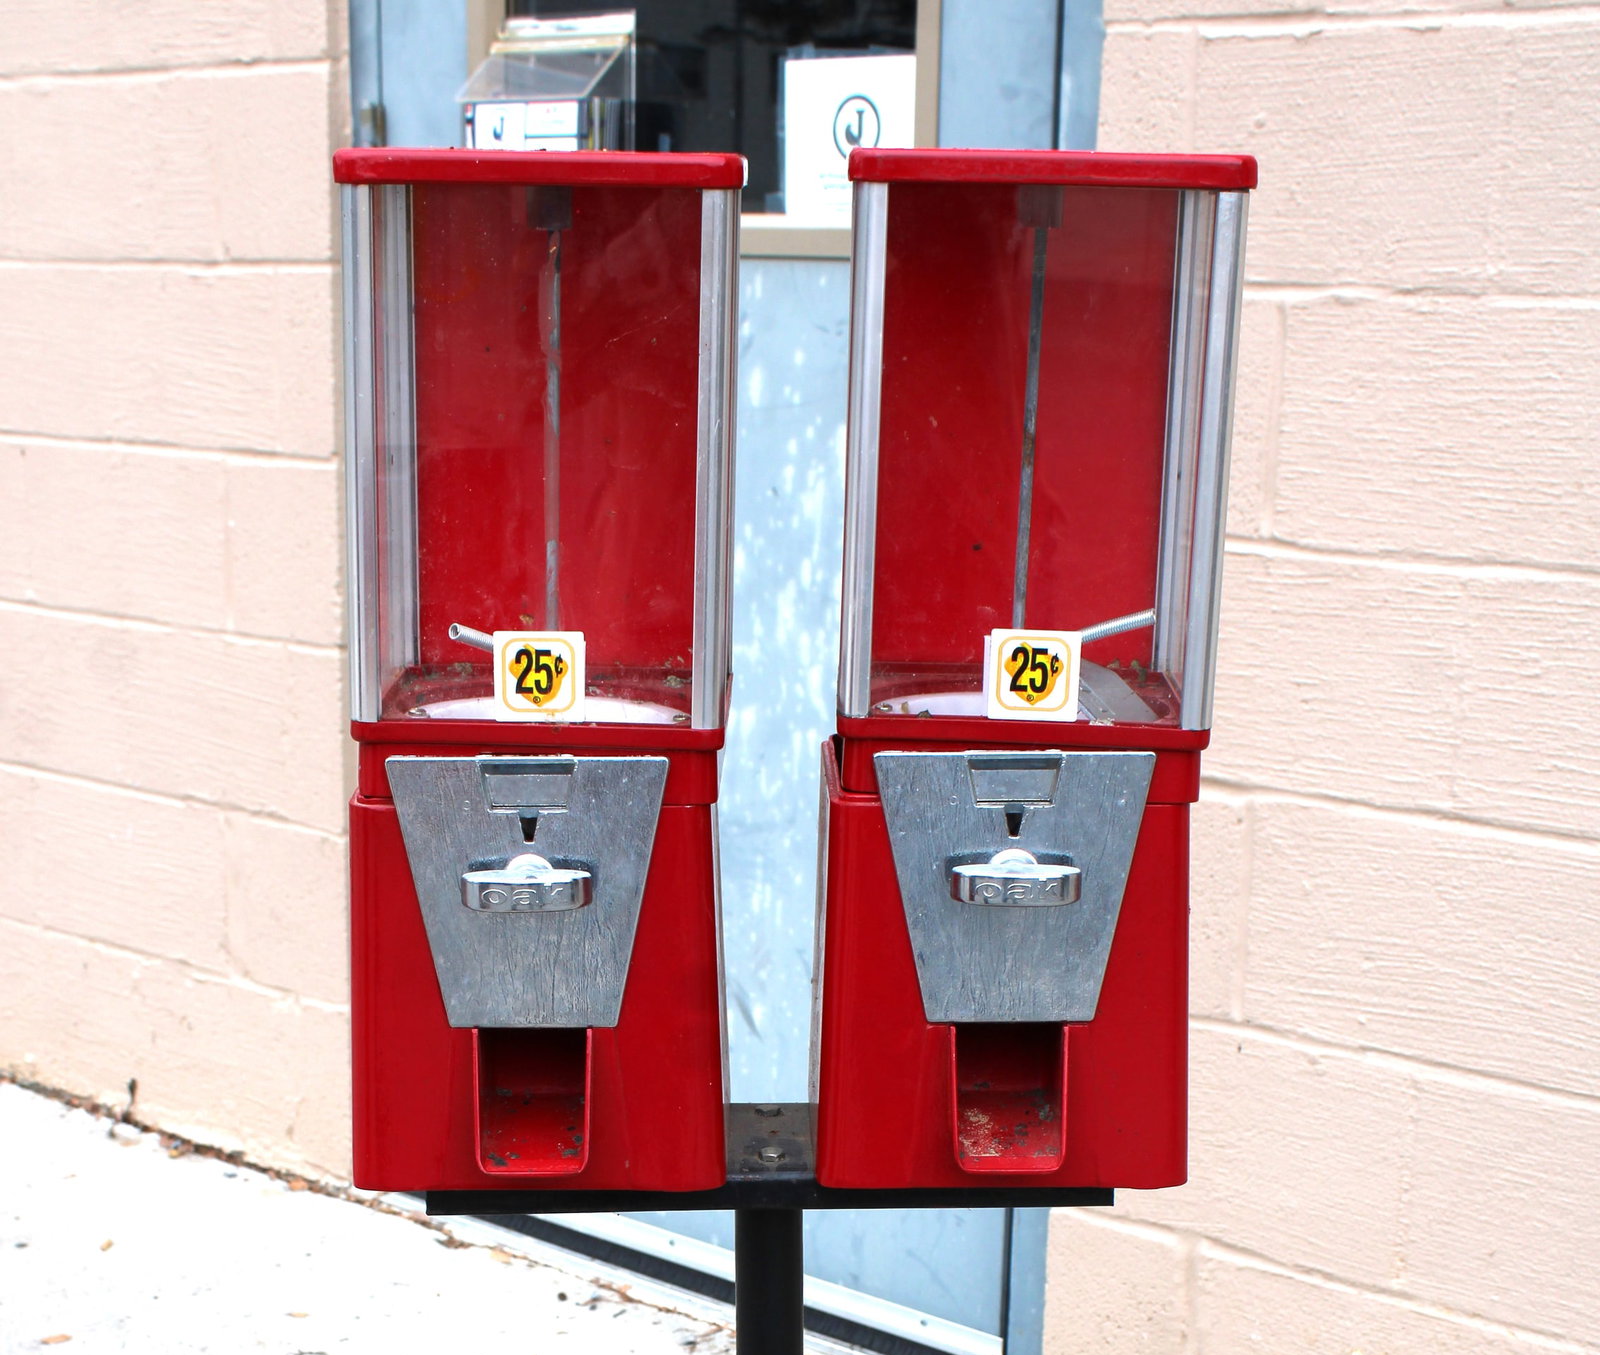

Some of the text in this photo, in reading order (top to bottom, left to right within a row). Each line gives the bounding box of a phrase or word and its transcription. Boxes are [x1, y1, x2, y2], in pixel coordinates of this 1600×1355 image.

[845, 108, 865, 147] J
[515, 648, 563, 695] 25¢
[1010, 646, 1059, 694] 25¢
